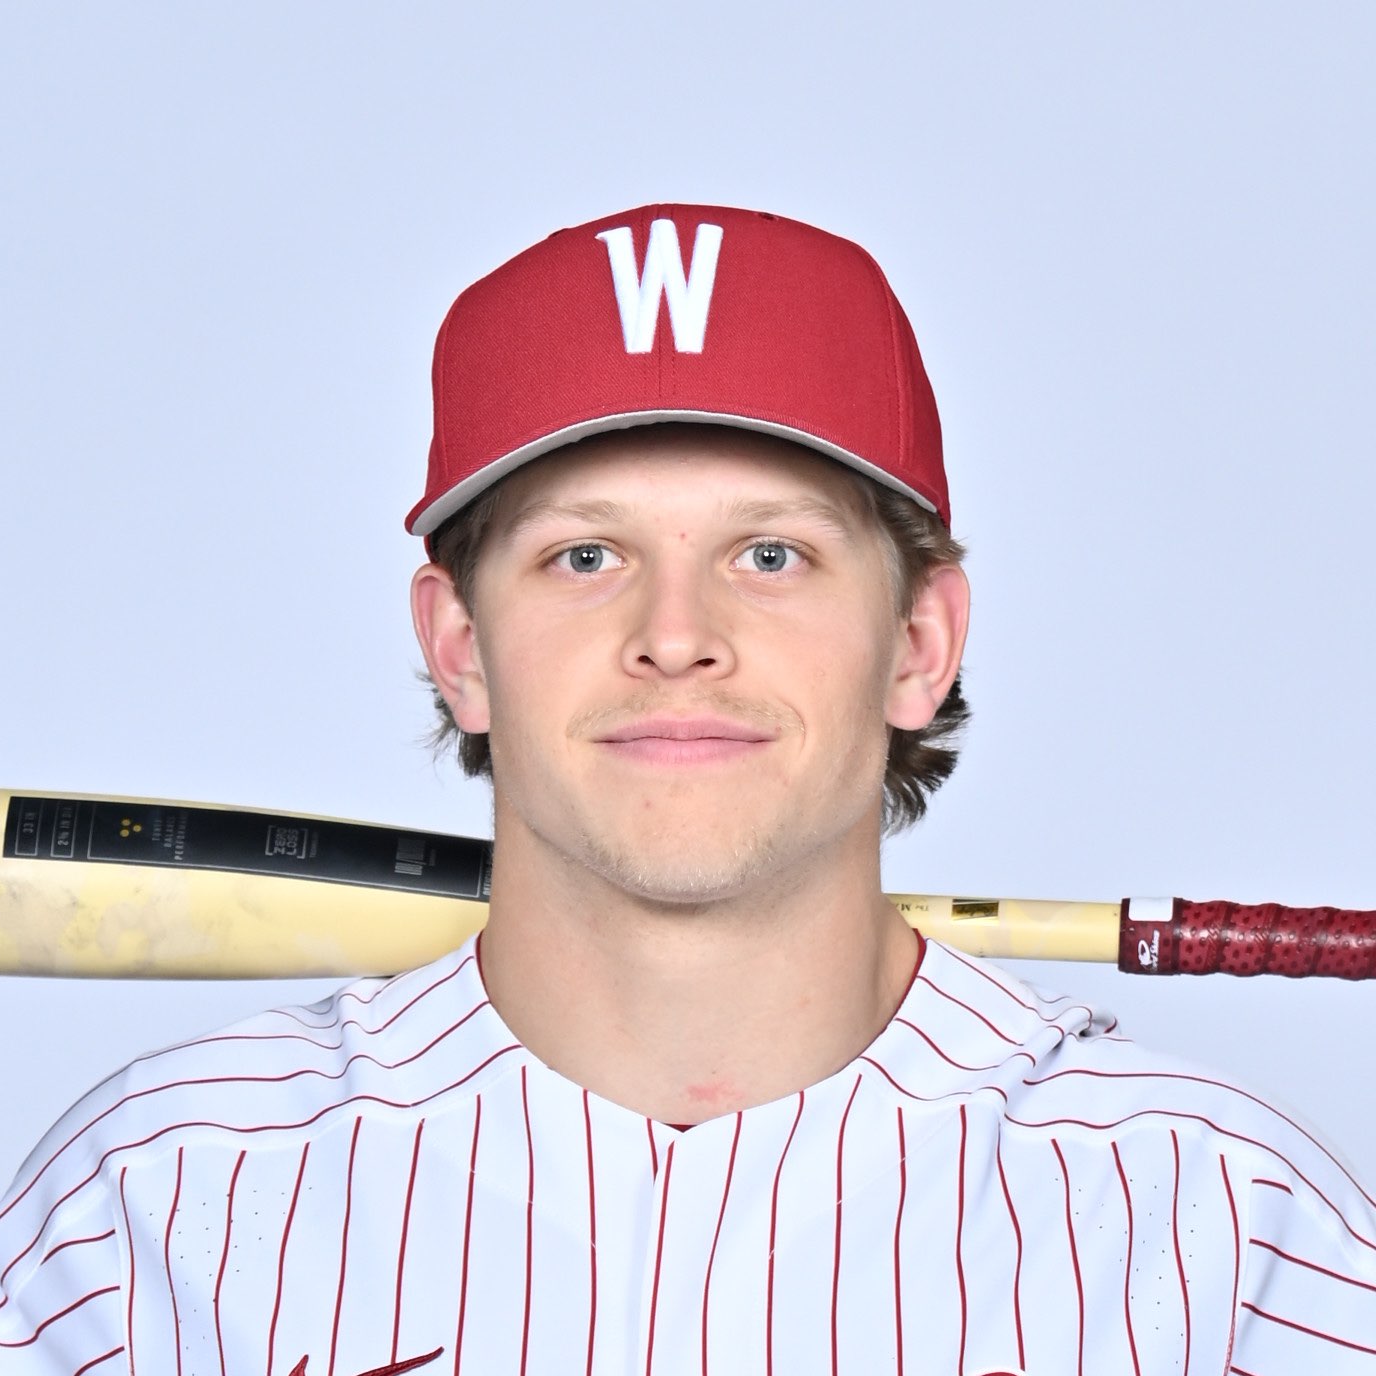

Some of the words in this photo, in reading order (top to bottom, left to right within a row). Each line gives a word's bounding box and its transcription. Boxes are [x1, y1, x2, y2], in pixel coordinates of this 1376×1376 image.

[595, 218, 724, 354] W
[273, 827, 287, 855] ZERO
[286, 828, 299, 856] LOSS
